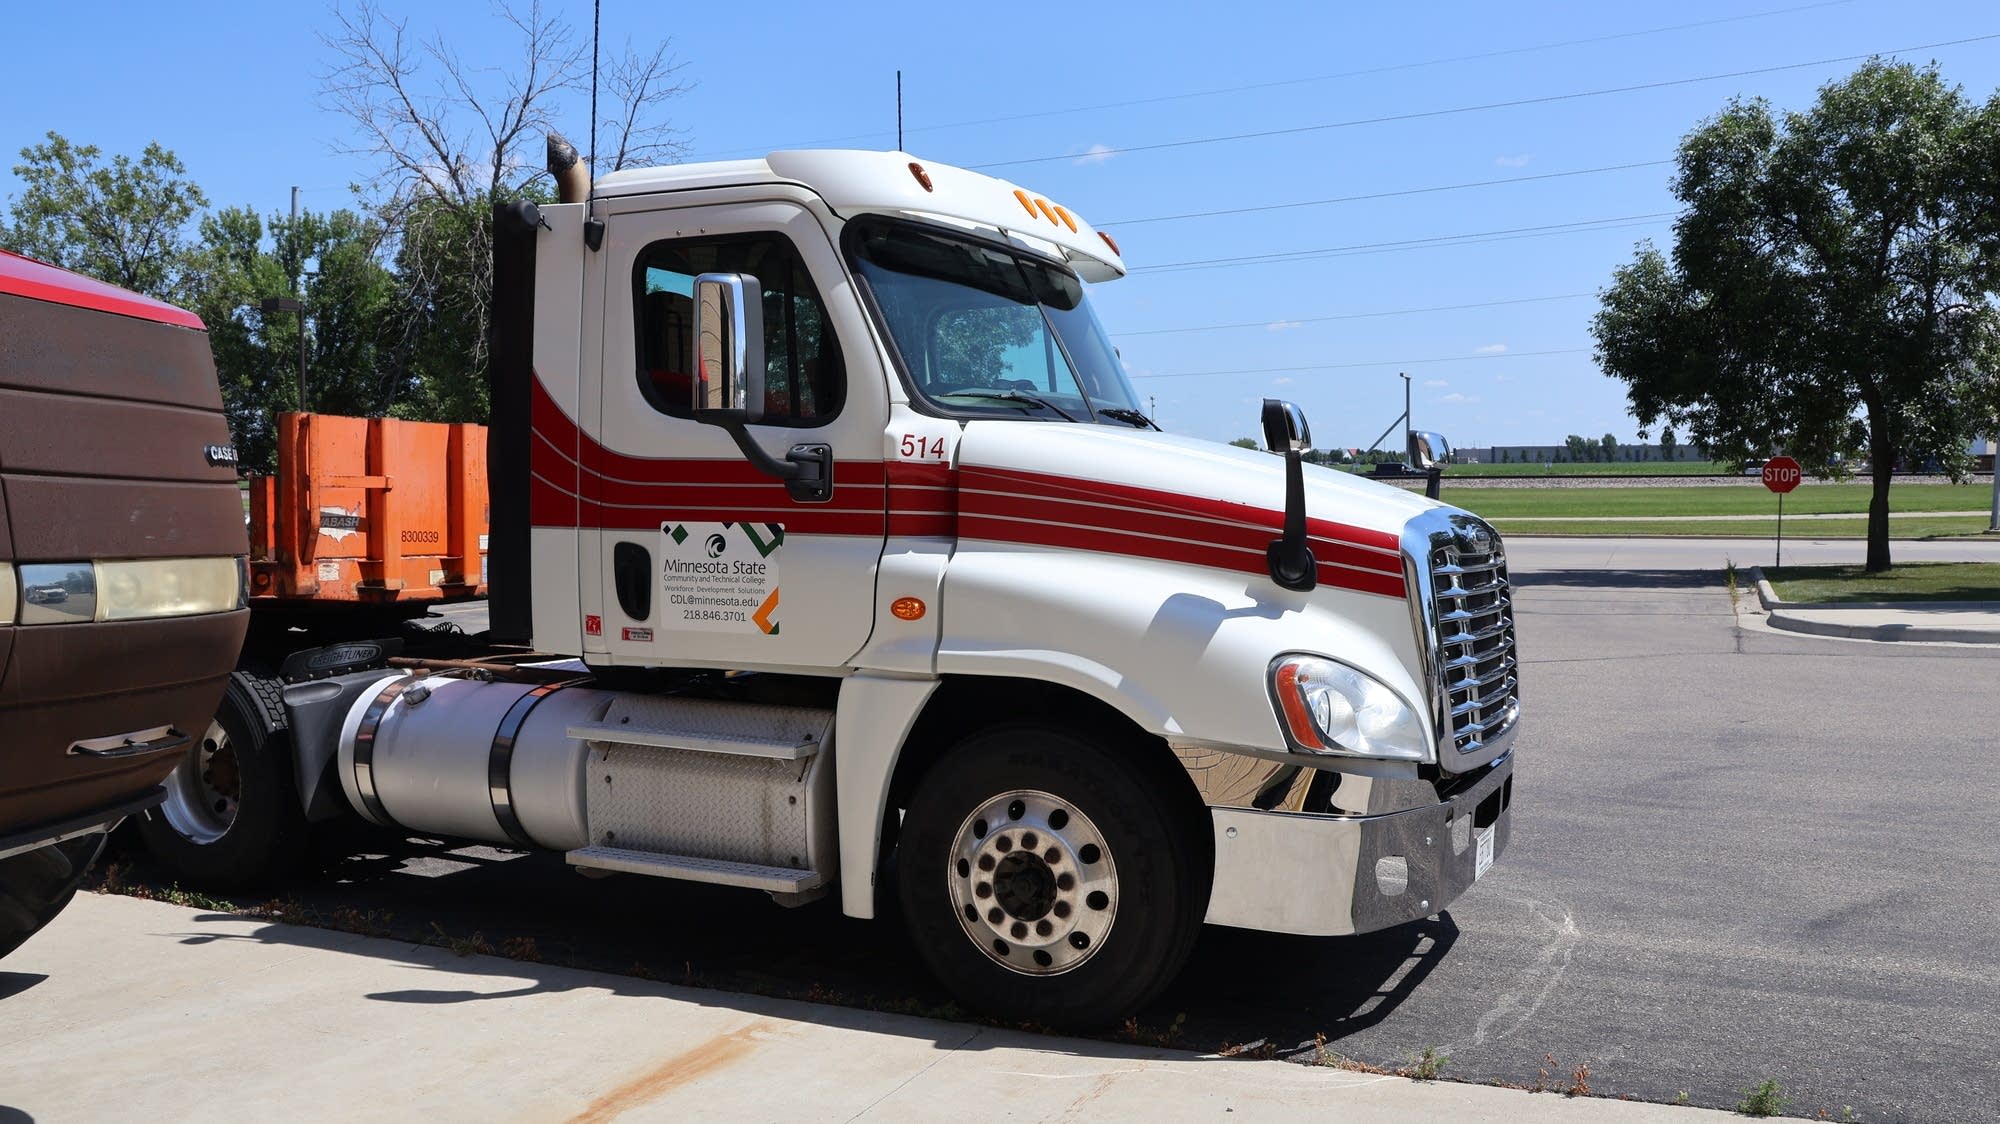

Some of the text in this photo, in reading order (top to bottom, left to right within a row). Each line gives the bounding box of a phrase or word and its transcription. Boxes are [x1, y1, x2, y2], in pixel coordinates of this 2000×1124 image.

[210, 445, 233, 460] CASE
[900, 434, 944, 459] 514
[1764, 468, 1799, 482] STOP
[401, 530, 439, 543] 8300339
[663, 559, 767, 575] Minnesota State
[663, 574, 766, 586] Community and Technical College
[664, 584, 766, 595] Workforce Development Solutions
[670, 594, 760, 607] CDL@minnesota.edu
[683, 609, 747, 622] 218.846.3701
